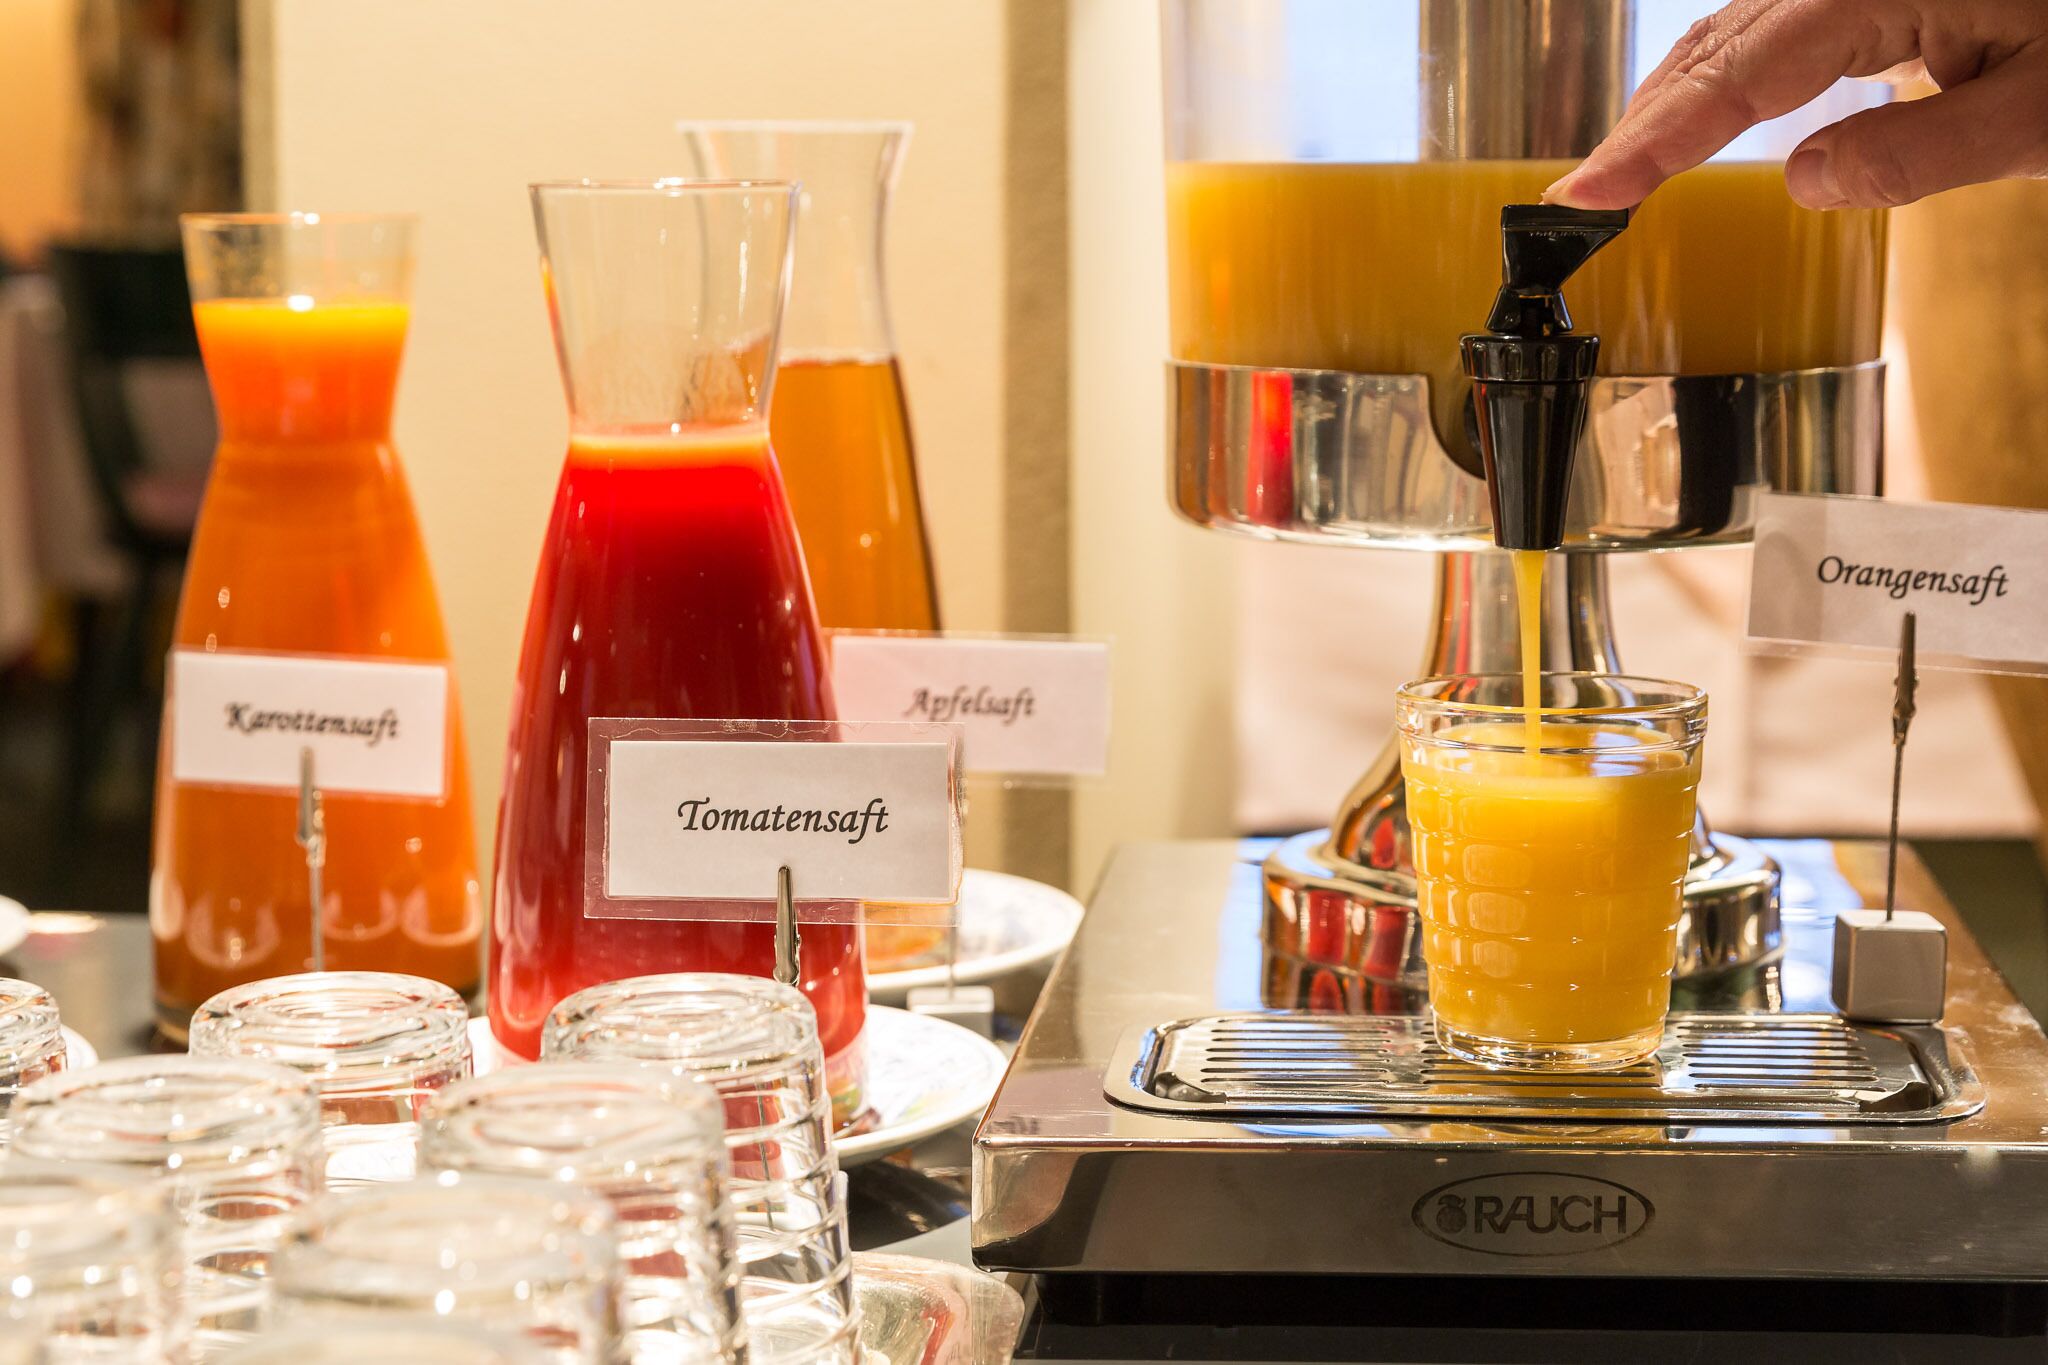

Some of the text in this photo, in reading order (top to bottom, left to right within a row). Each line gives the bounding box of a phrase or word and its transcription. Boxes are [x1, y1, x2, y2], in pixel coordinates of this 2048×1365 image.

[1817, 555, 2008, 606] Orangensaft
[224, 702, 399, 748] Karottensaft
[903, 685, 1036, 726] Apfelsaft
[677, 797, 889, 845] Tomatensaft
[1474, 1195, 1627, 1234] RAUCH
